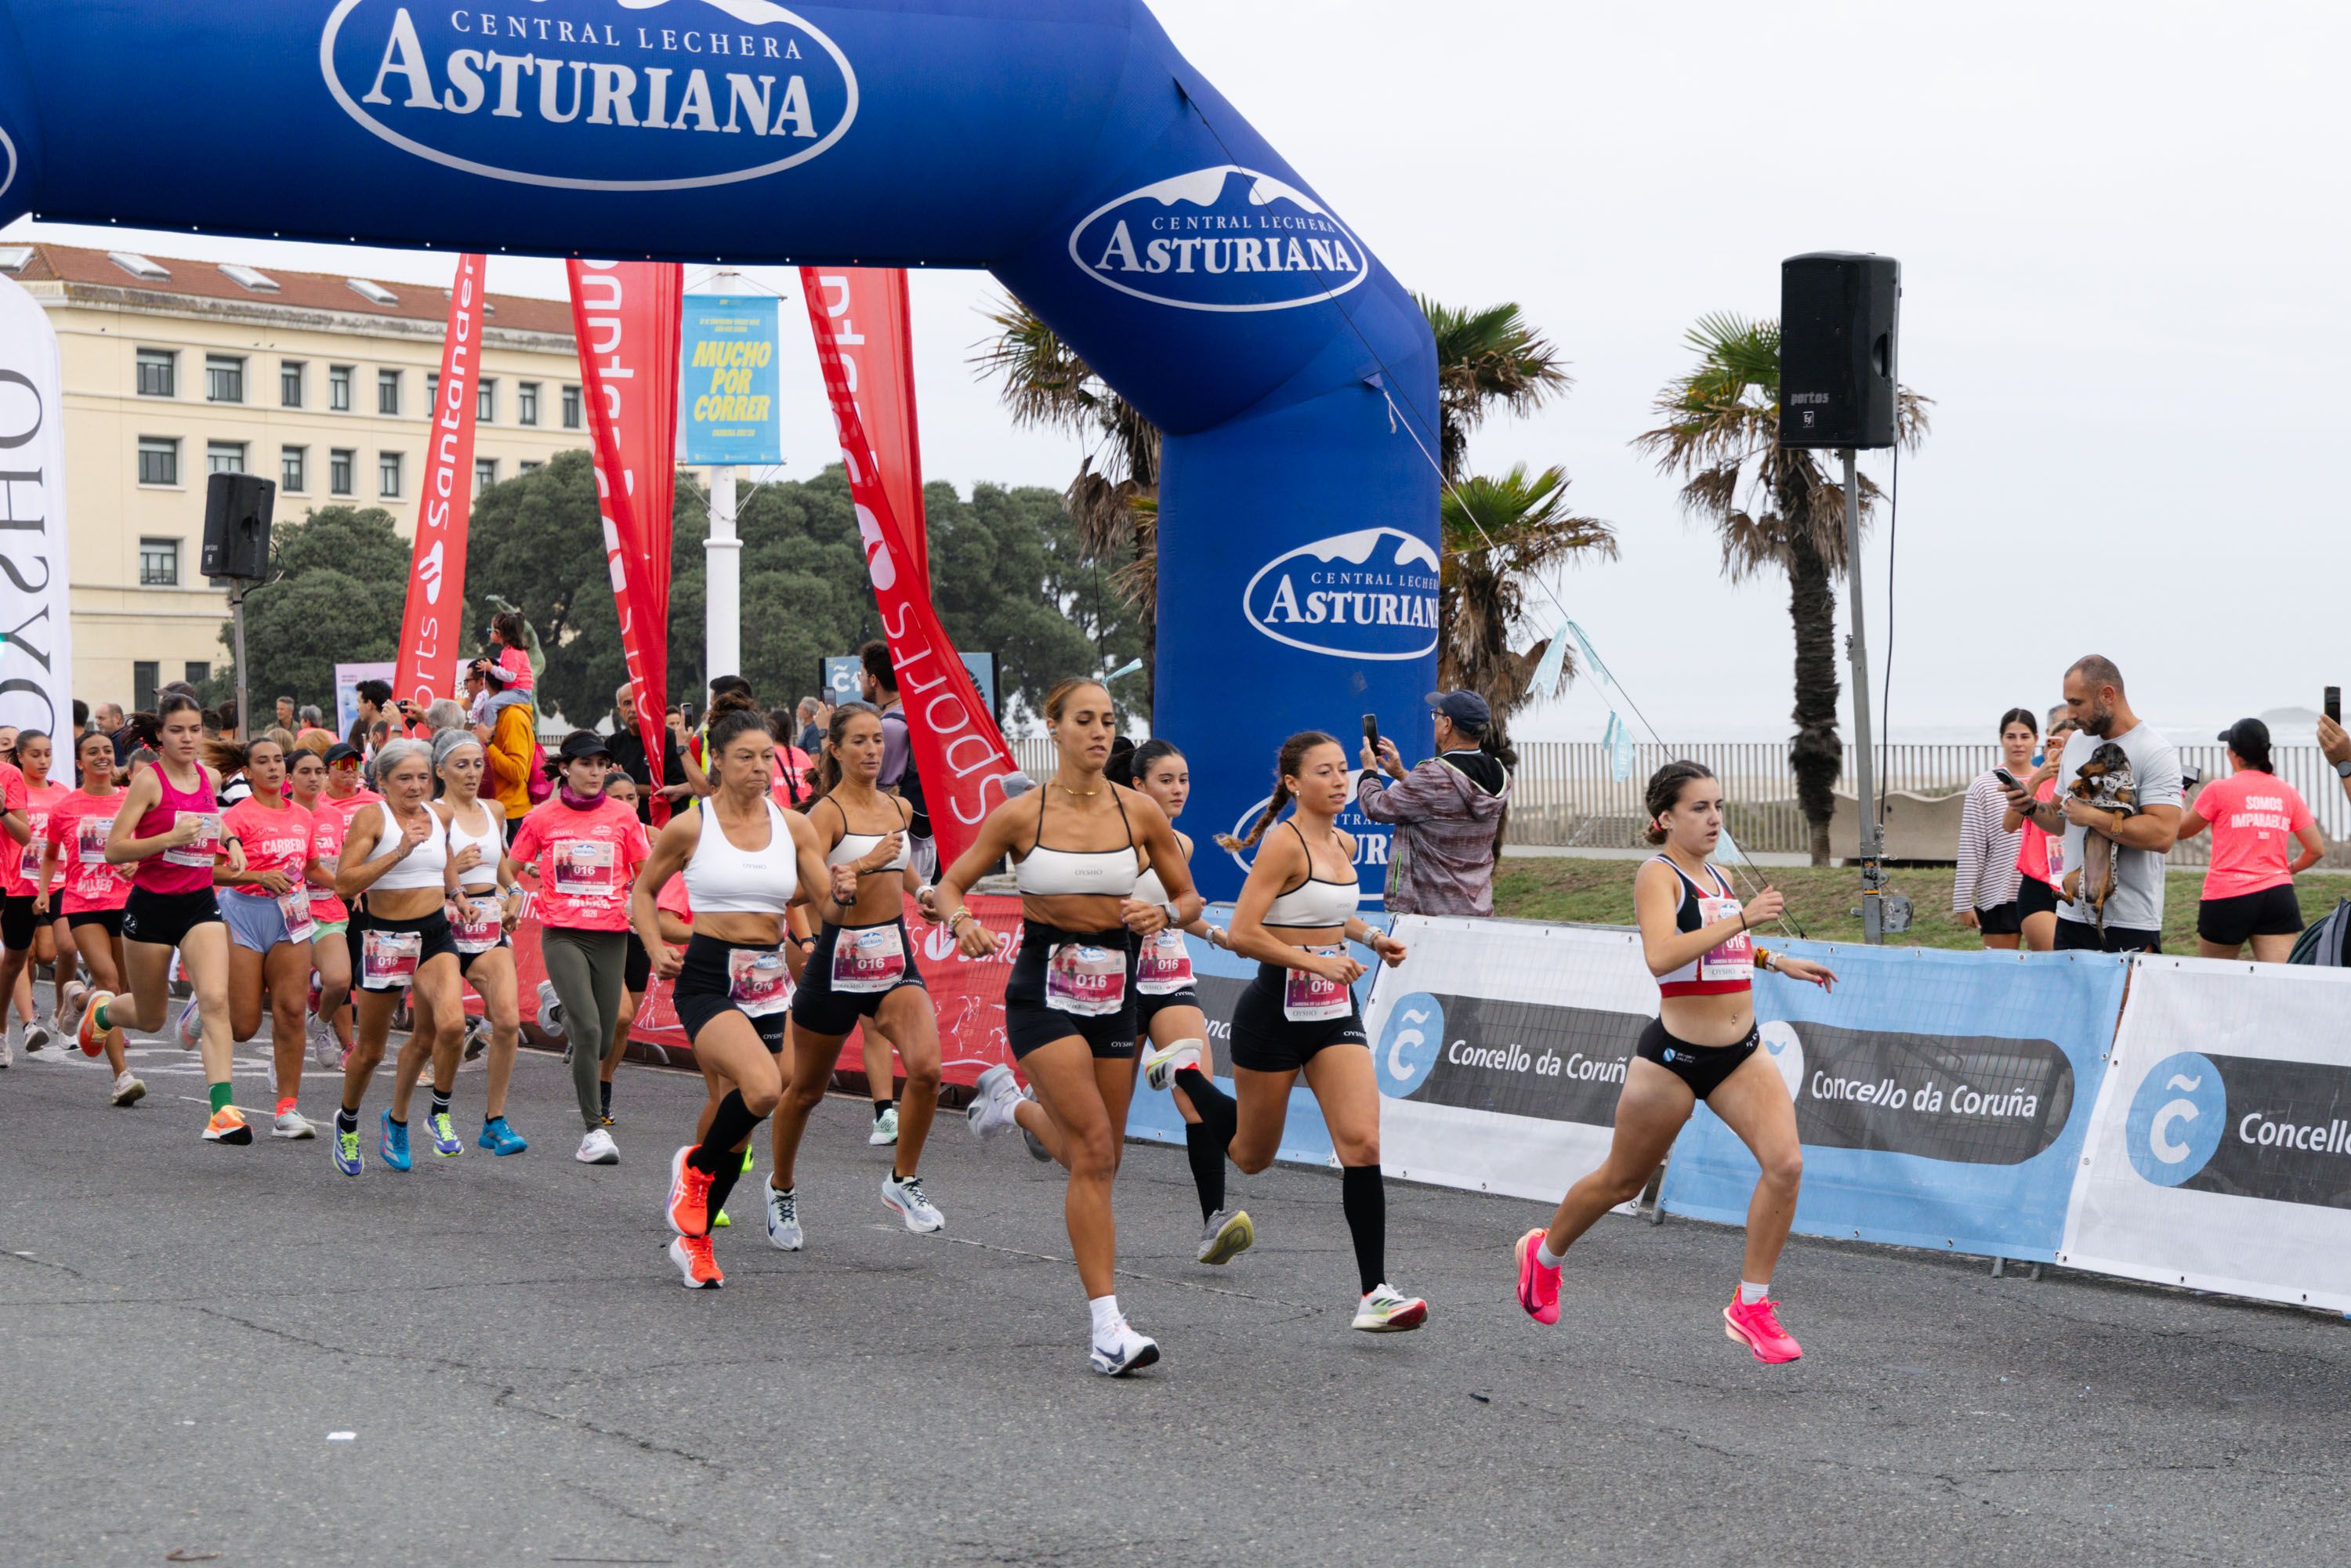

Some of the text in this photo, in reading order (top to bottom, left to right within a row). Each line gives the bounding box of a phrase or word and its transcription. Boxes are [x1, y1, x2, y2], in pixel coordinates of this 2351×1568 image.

[451, 10, 802, 60] CENTRAL LECHERA
[362, 8, 817, 137] ASTURIANA
[1152, 215, 1335, 233] CENTRAL LECHERA
[1095, 219, 1358, 273] ASTURIANA
[691, 340, 772, 368] MUCHO
[710, 368, 752, 394] POR
[428, 252, 475, 531] Santander
[694, 394, 771, 422] CORRER
[1311, 572, 1393, 586] CENTRAL
[2245, 795, 2283, 812] SOMOS
[262, 838, 306, 855] CARRERA
[574, 865, 596, 875] 016
[465, 922, 487, 932] 016
[857, 958, 885, 969] 016
[1157, 959, 1179, 970] 016
[1076, 974, 1107, 988] 016
[1311, 980, 1335, 993] 016
[1449, 1040, 1628, 1084] Concello da Coruñ
[1812, 1070, 2038, 1117] Concello da Coruña
